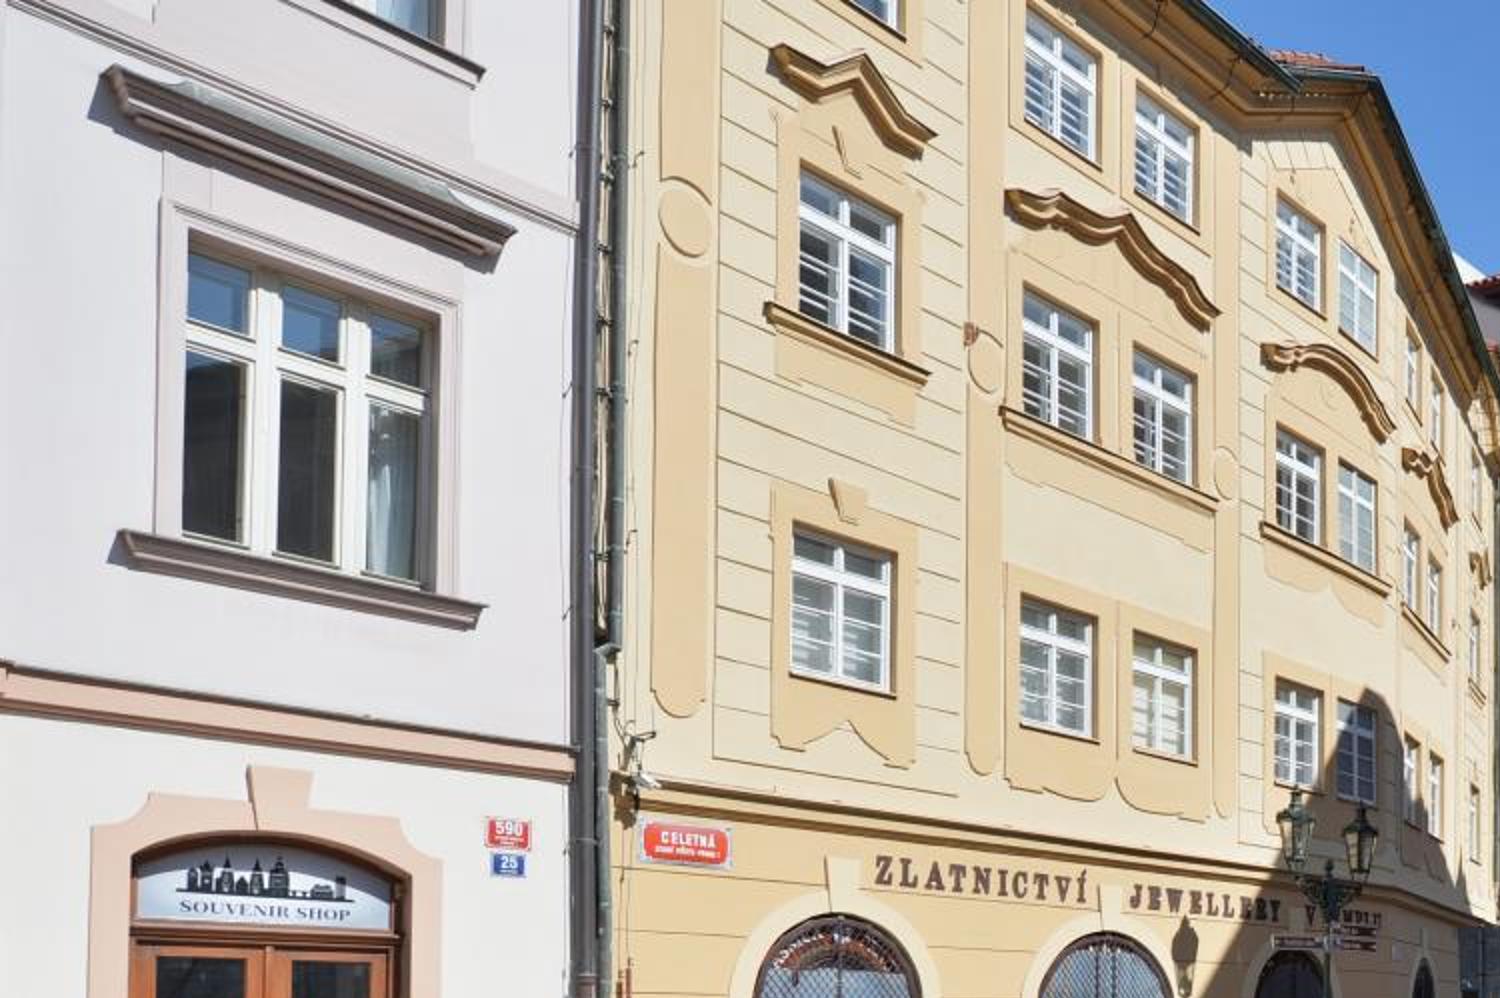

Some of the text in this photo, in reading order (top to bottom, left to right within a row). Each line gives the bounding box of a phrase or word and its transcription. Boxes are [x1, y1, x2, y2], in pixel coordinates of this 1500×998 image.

[495, 820, 524, 836] 590
[661, 831, 716, 848] CELETNÁ
[500, 855, 518, 869] 25
[874, 854, 1088, 904] ZLATNICTVÍ
[1129, 883, 1281, 922] JEWELLERY
[179, 899, 350, 921] SOUVENIR SHOP
